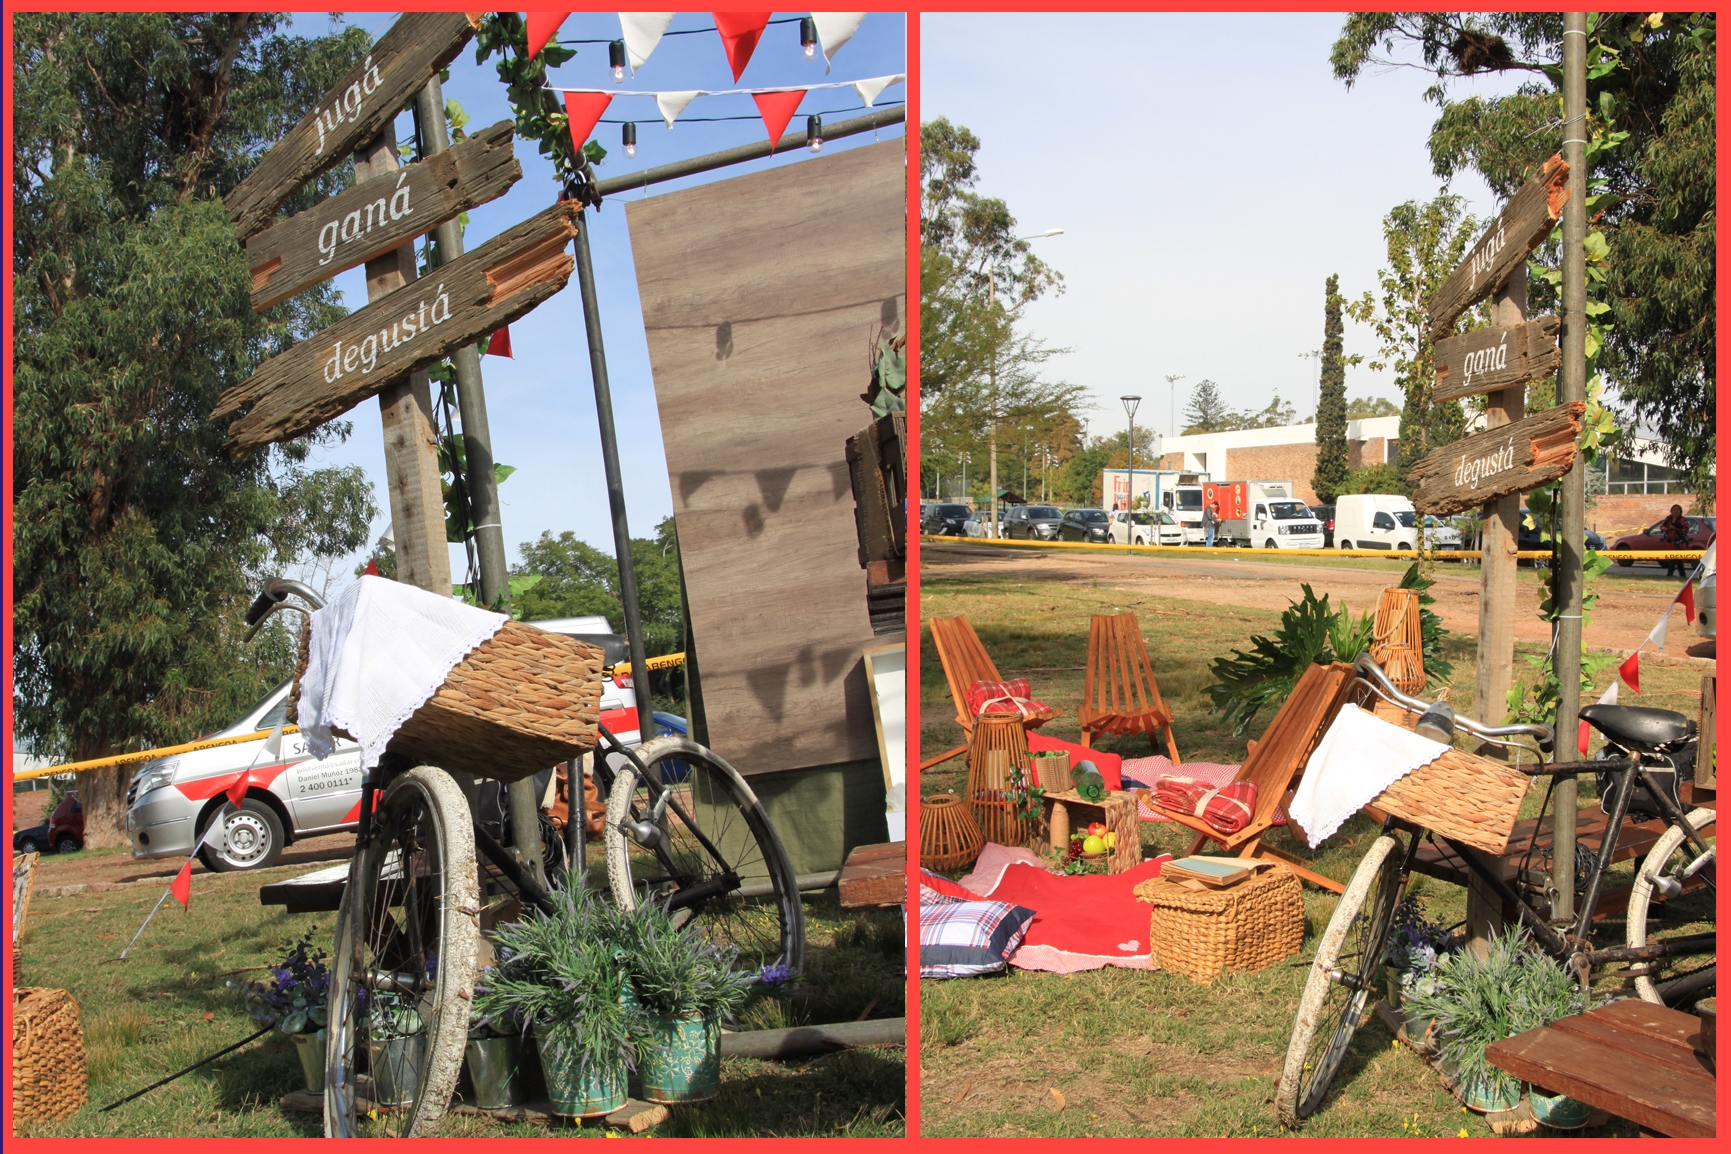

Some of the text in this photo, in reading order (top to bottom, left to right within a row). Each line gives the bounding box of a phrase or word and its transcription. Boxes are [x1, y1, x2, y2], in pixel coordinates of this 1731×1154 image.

[312, 55, 384, 156] jugá
[318, 172, 414, 265] ganá
[1470, 217, 1506, 290] jugá
[324, 284, 453, 384] degustá
[1463, 331, 1507, 386] ganá
[1454, 437, 1515, 490] degustá
[298, 773, 320, 782] Daniel
[300, 785, 306, 793] 2
[308, 782, 325, 791] 400
